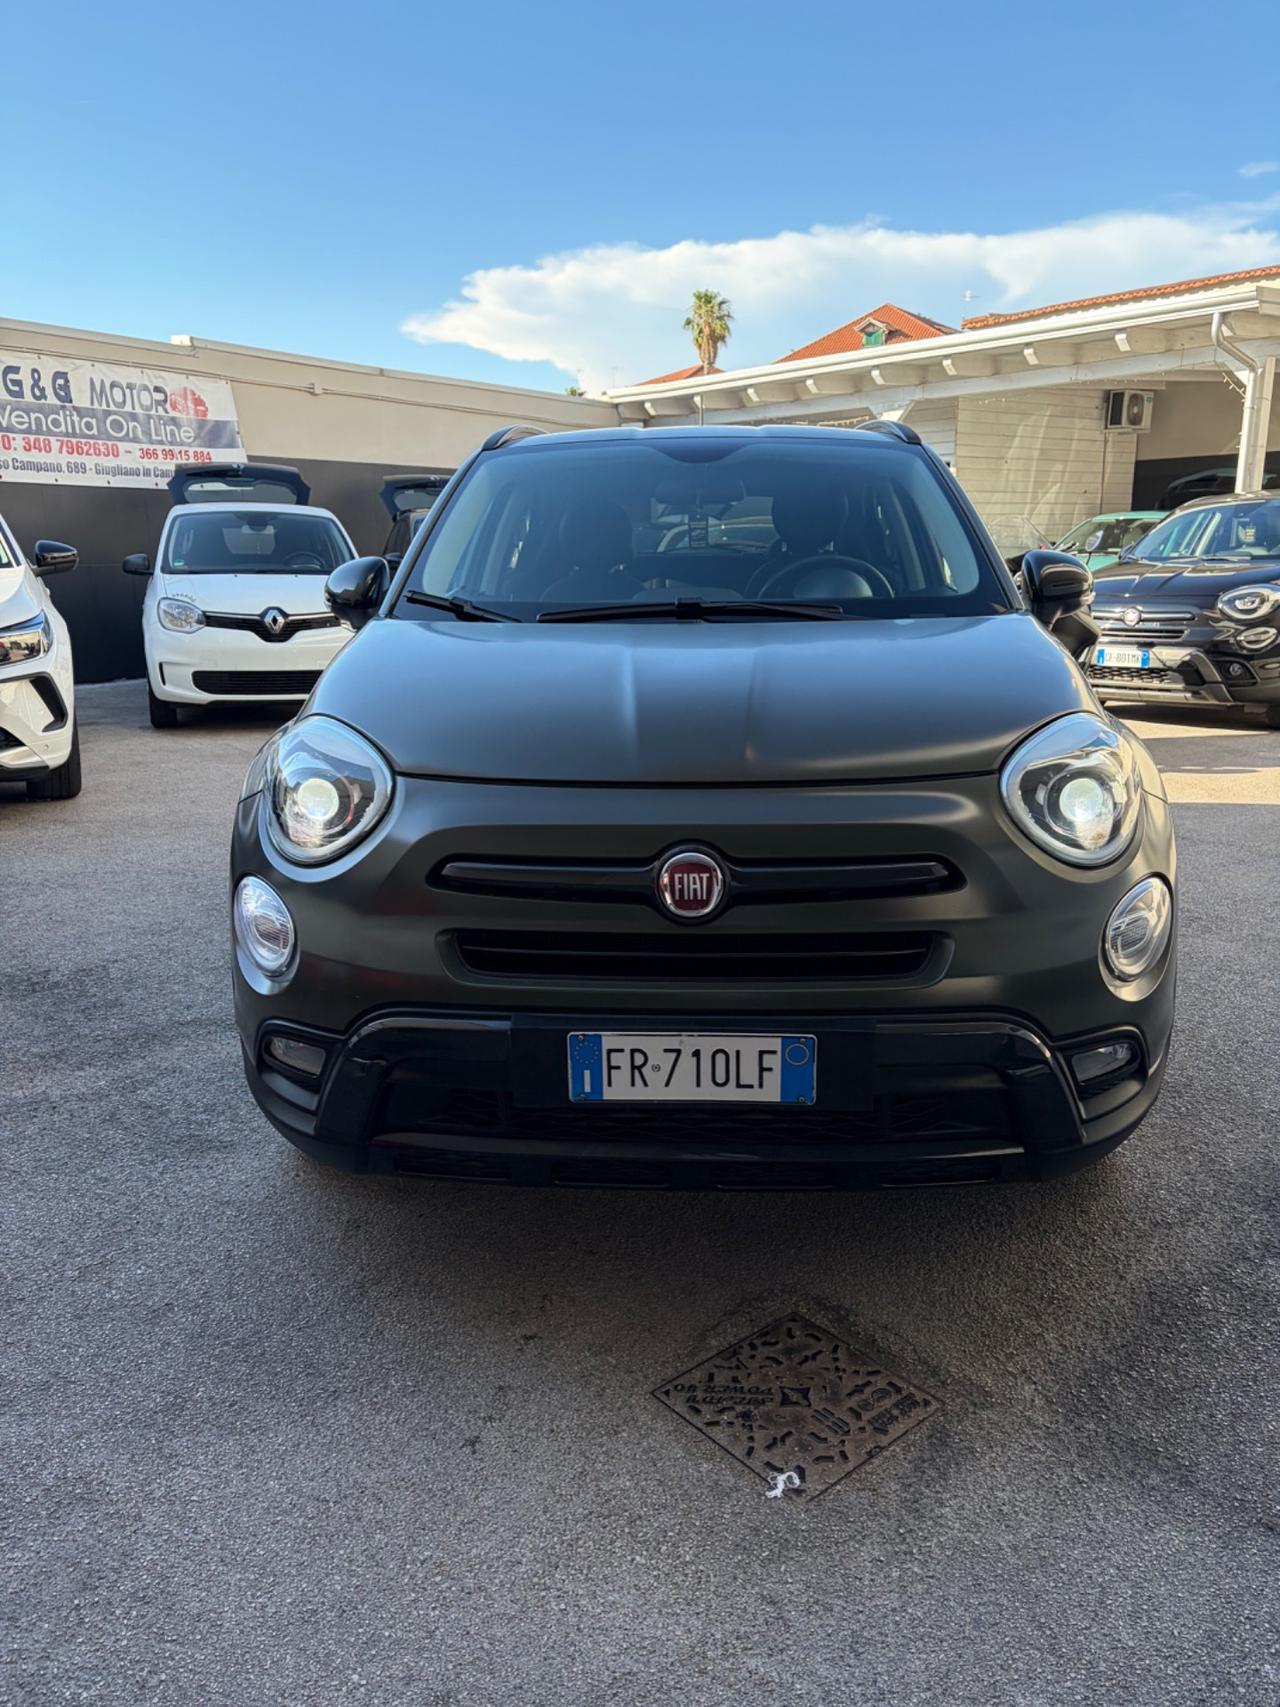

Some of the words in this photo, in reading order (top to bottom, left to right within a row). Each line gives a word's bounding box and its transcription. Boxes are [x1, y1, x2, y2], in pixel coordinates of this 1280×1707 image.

[0, 405, 97, 436] Vendita
[106, 415, 142, 439] On
[151, 418, 195, 444] Line
[56, 439, 119, 458] 7962630
[139, 448, 159, 461] 366
[193, 450, 212, 463] 884
[67, 460, 87, 474] 689
[674, 873, 709, 900] FIAT
[606, 1048, 778, 1089] FR710LF
